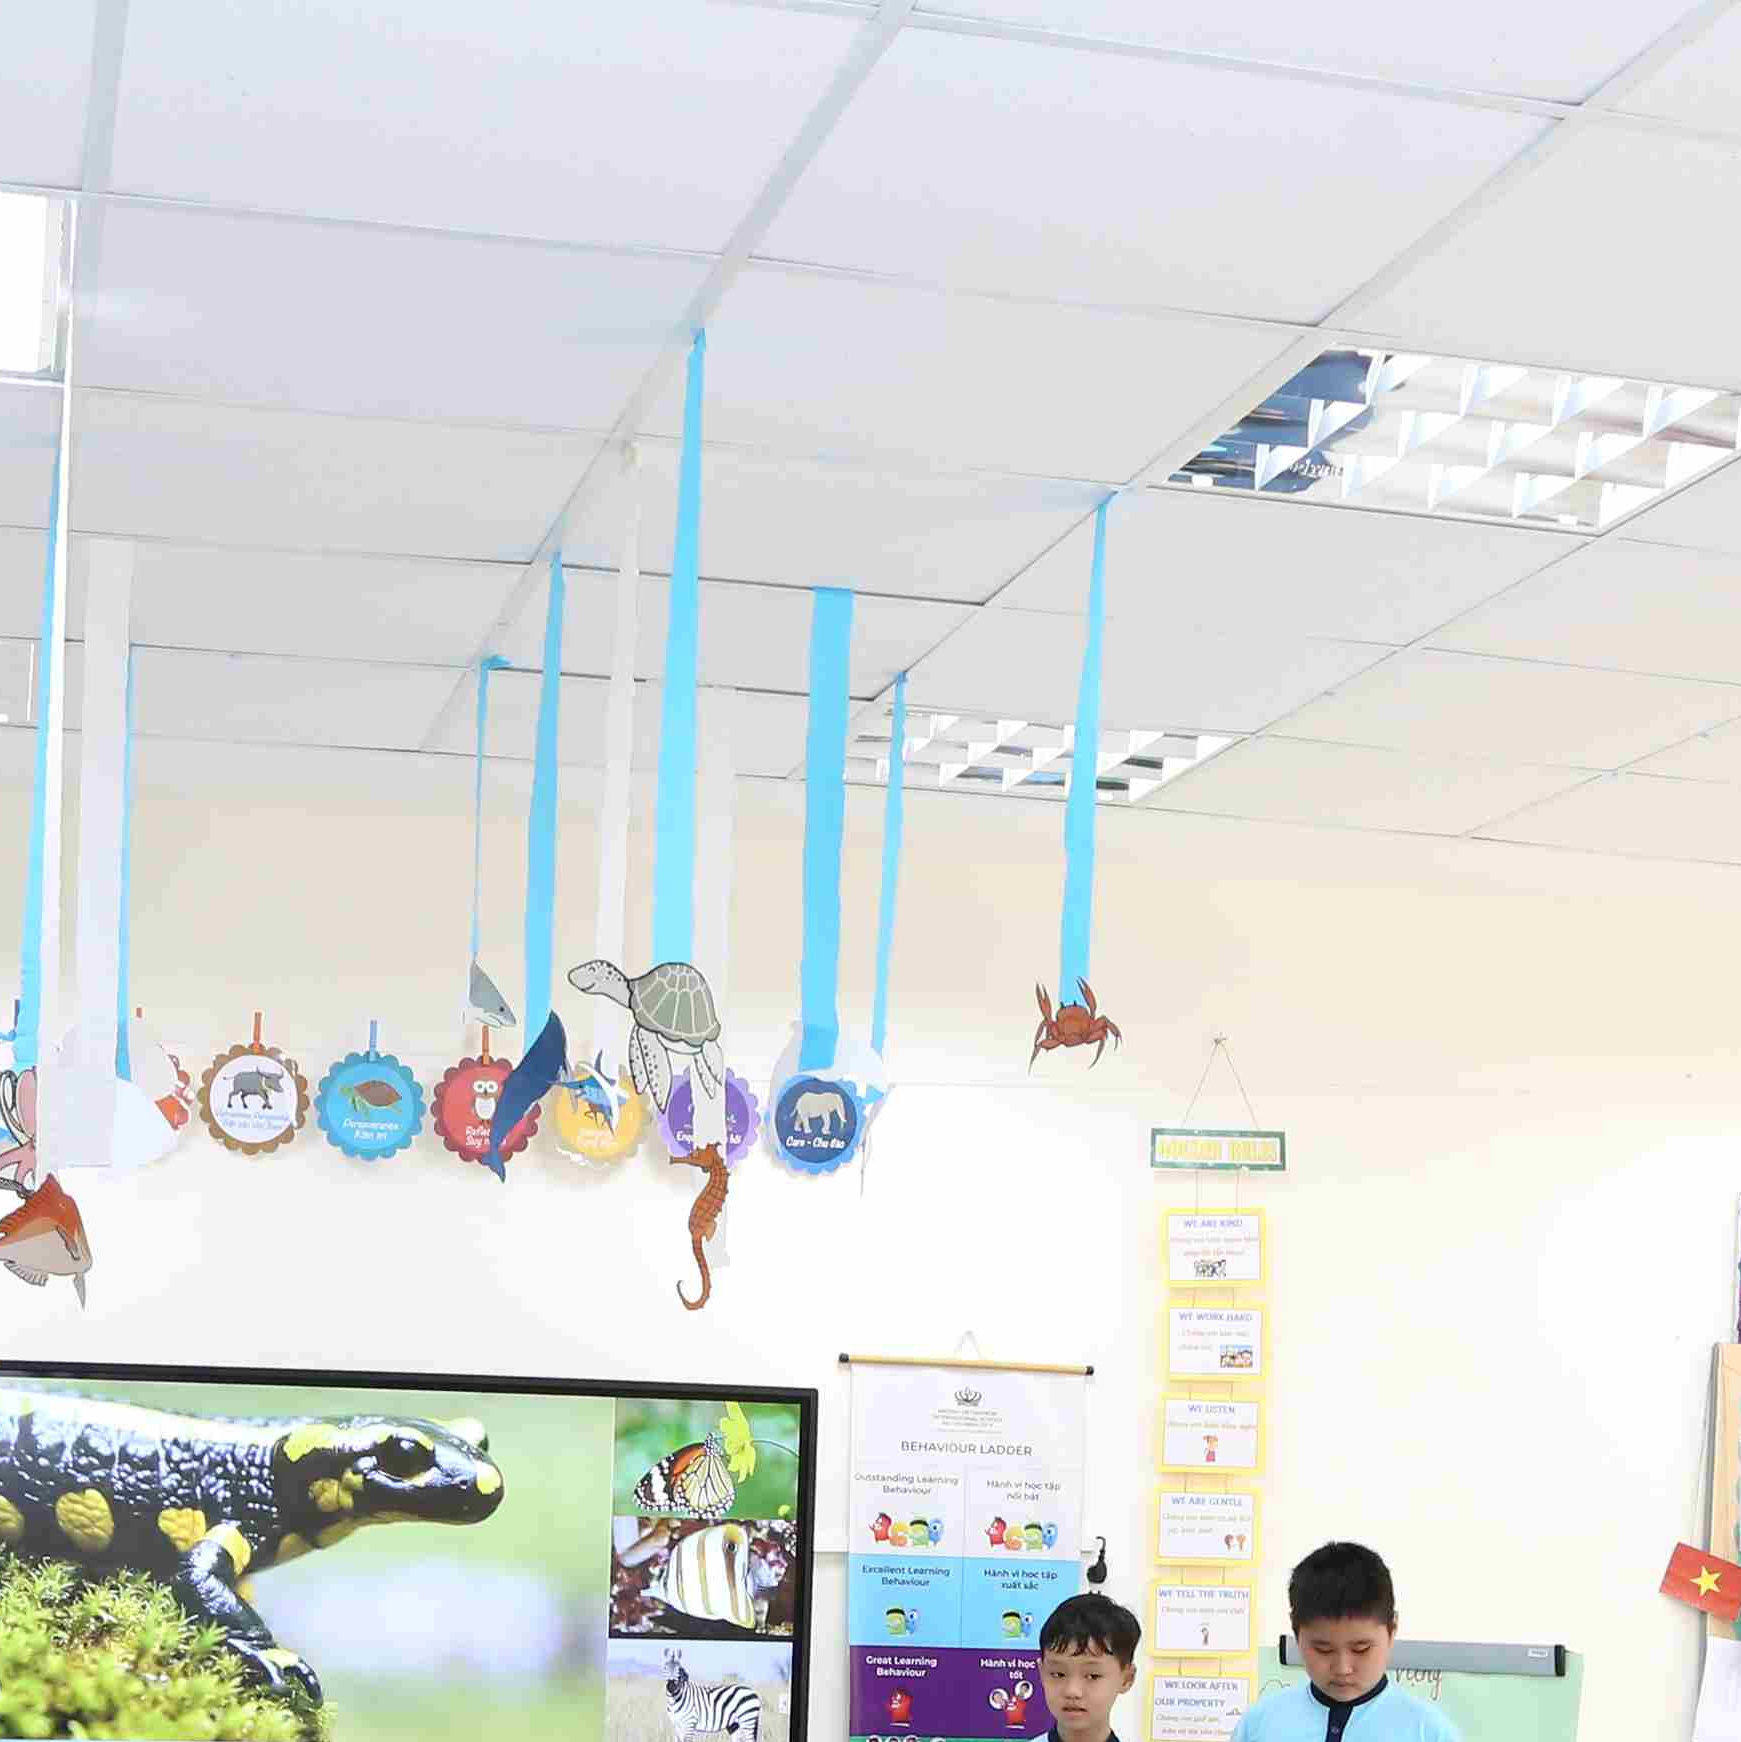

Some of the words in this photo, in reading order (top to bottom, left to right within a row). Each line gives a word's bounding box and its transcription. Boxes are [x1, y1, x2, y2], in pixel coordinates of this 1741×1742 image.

[901, 1440, 977, 1454] BEHAVIOUR
[979, 1444, 1033, 1457] LADDER
[853, 1472, 915, 1485] Outstanding
[882, 1484, 932, 1496] Behaviour
[861, 1564, 906, 1577] Excellent
[907, 1566, 951, 1579] Learning
[881, 1575, 931, 1588] Behaviour
[865, 1655, 893, 1666] Great
[893, 1655, 938, 1669] Learning
[980, 1658, 1006, 1670] Hành
[876, 1666, 927, 1679] Behaviour
